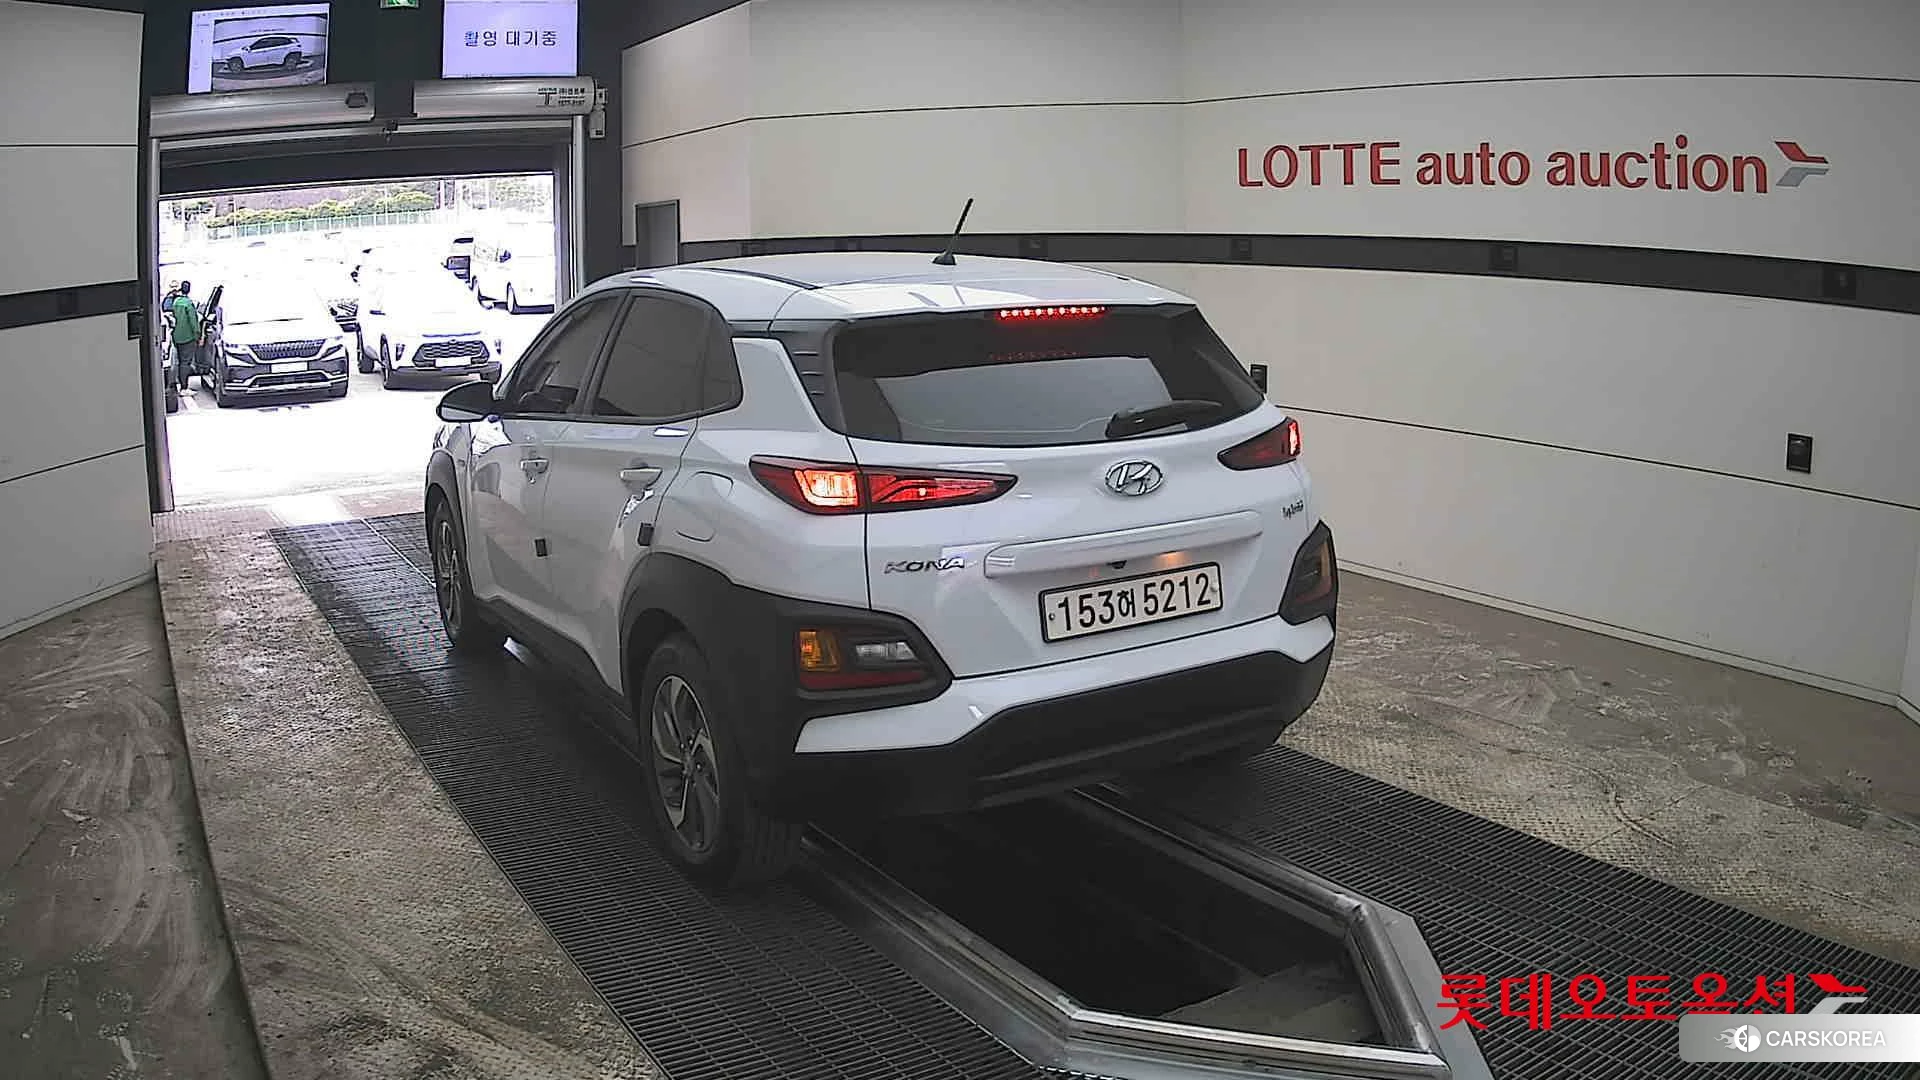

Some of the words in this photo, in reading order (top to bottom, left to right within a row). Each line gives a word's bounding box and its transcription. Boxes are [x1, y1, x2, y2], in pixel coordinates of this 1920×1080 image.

[505, 30, 557, 46] 대기중
[1238, 142, 1399, 188] LOTTE
[1416, 141, 1531, 185] auto
[1546, 135, 1768, 193] auction
[884, 557, 966, 574] KONA
[1057, 588, 1136, 632] 153허
[1143, 572, 1211, 616] 5212
